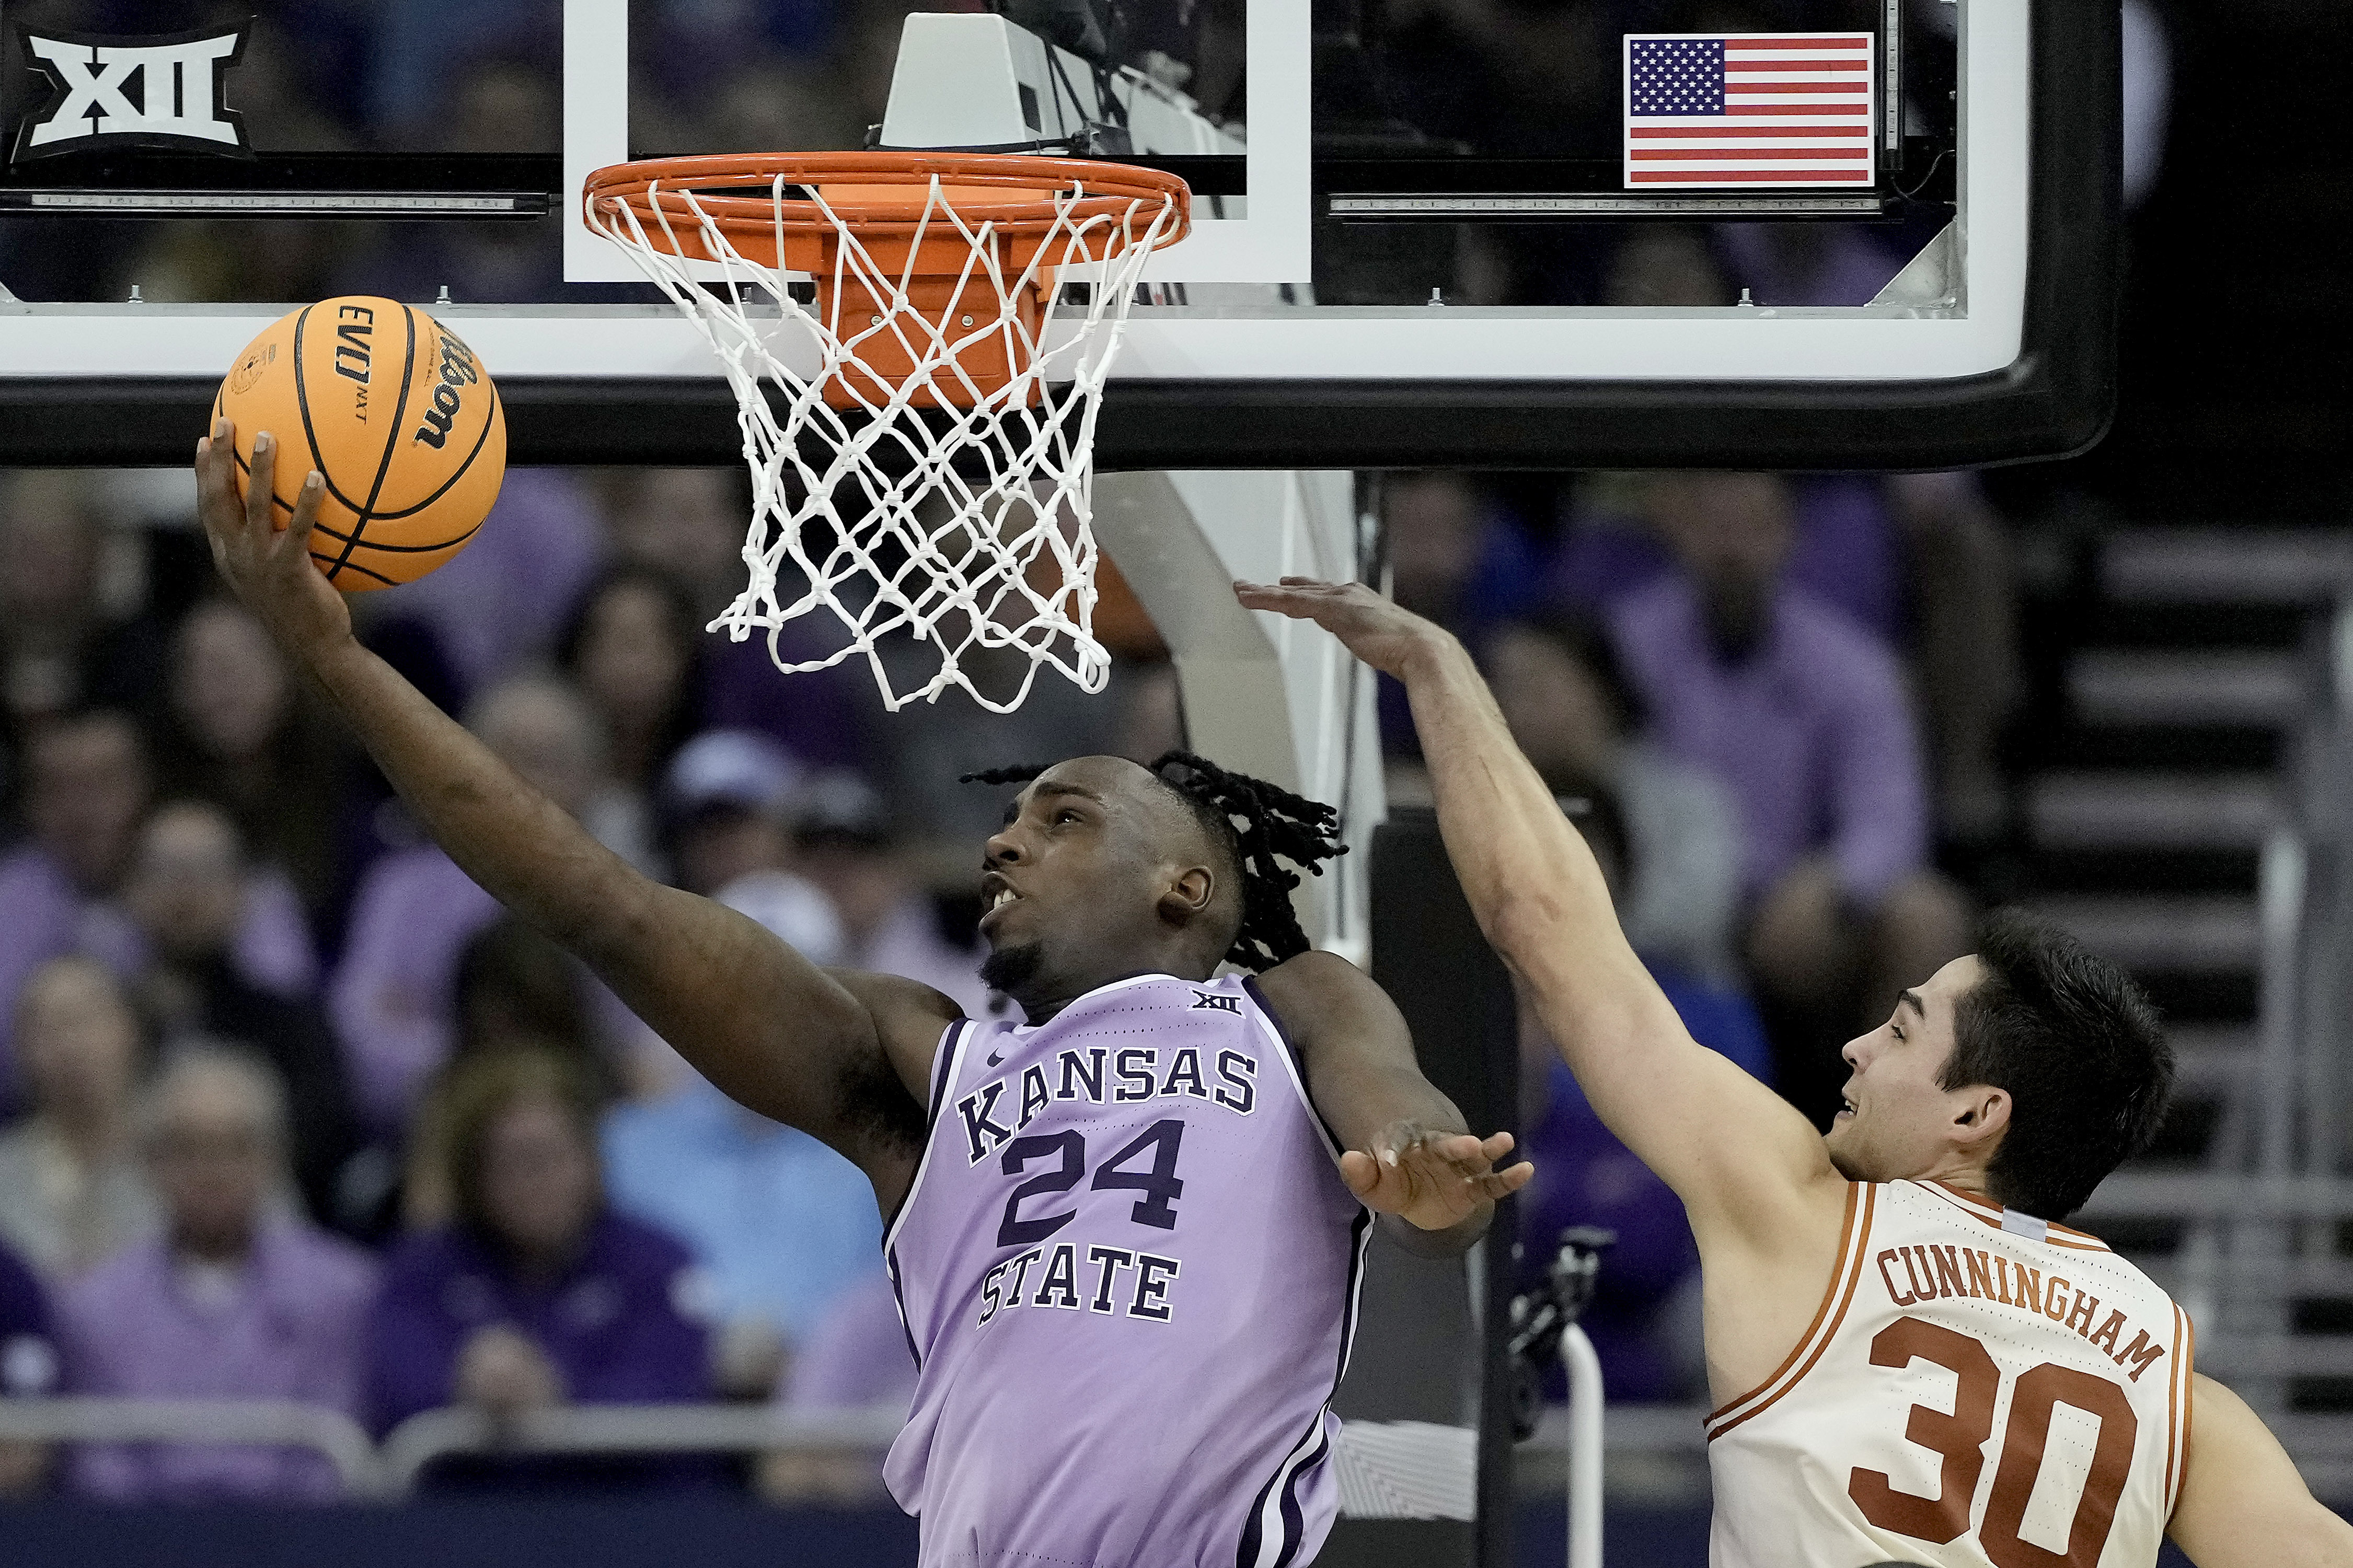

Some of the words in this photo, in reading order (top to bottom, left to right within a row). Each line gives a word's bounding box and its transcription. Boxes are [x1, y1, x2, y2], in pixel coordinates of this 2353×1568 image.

[29, 32, 239, 147] XII
[335, 305, 374, 385] EVO
[356, 386, 368, 426] NXT
[1191, 988, 1243, 1017] XII
[955, 1047, 1258, 1169] KANSAS
[996, 1119, 1185, 1248] 24
[976, 1242, 1182, 1331] STATE
[1876, 1244, 2166, 1384] CUNNINGHAM
[1848, 1316, 2138, 1568] 30
